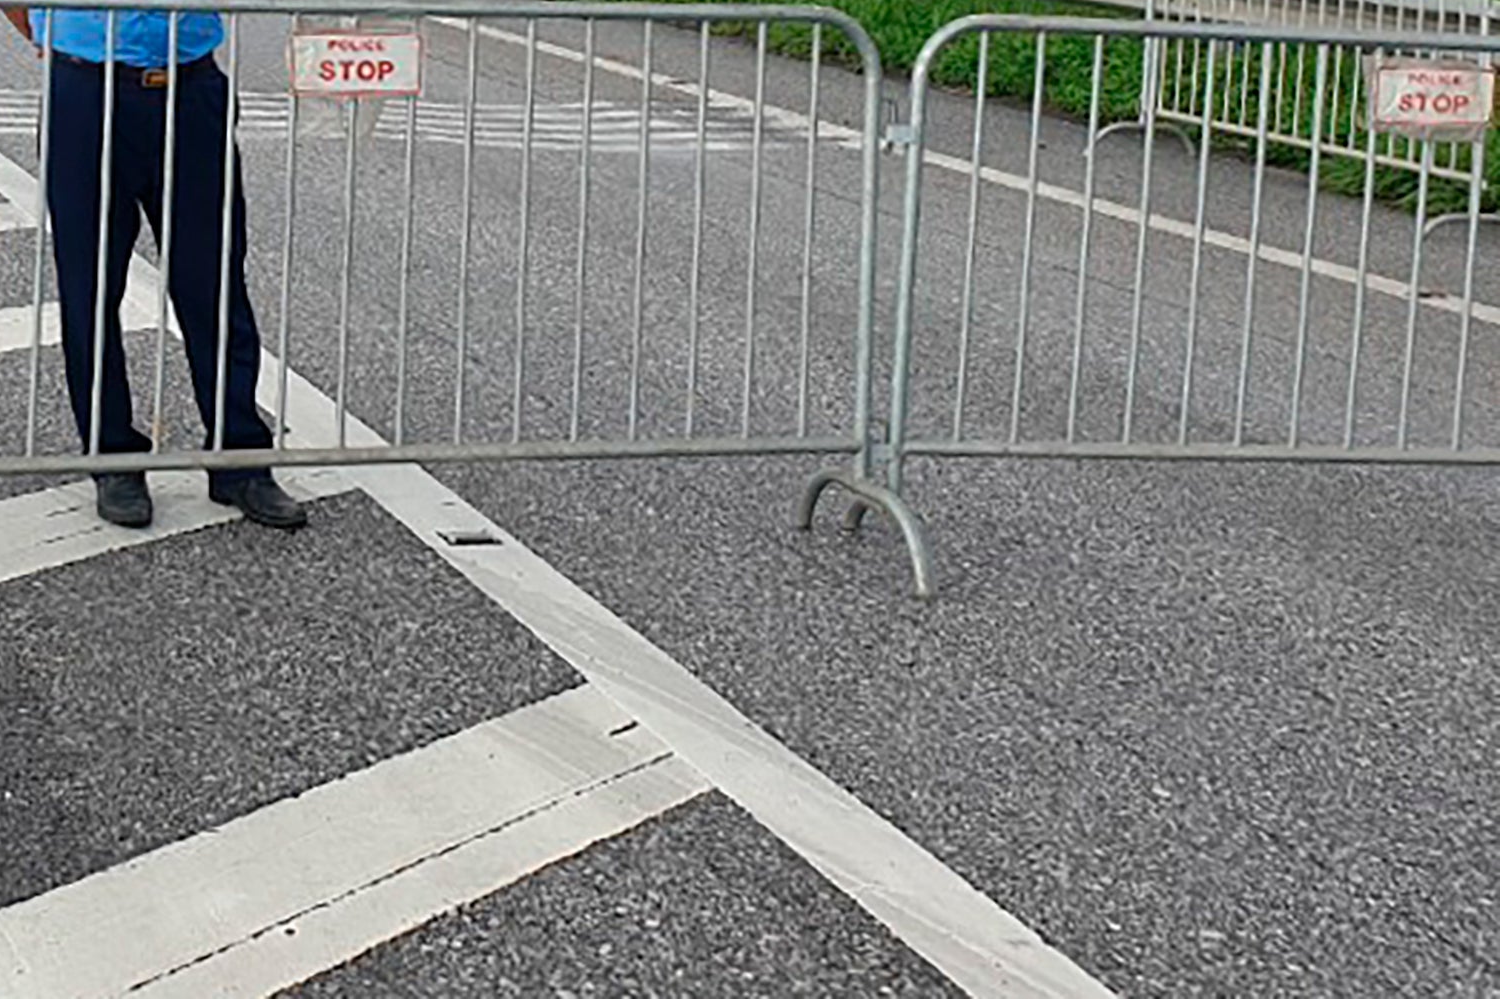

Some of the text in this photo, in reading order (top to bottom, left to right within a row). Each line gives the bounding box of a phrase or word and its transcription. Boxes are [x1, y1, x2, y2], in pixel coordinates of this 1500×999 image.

[327, 39, 385, 52] POLICE
[319, 60, 394, 81] STOP
[1398, 92, 1469, 113] STOP
